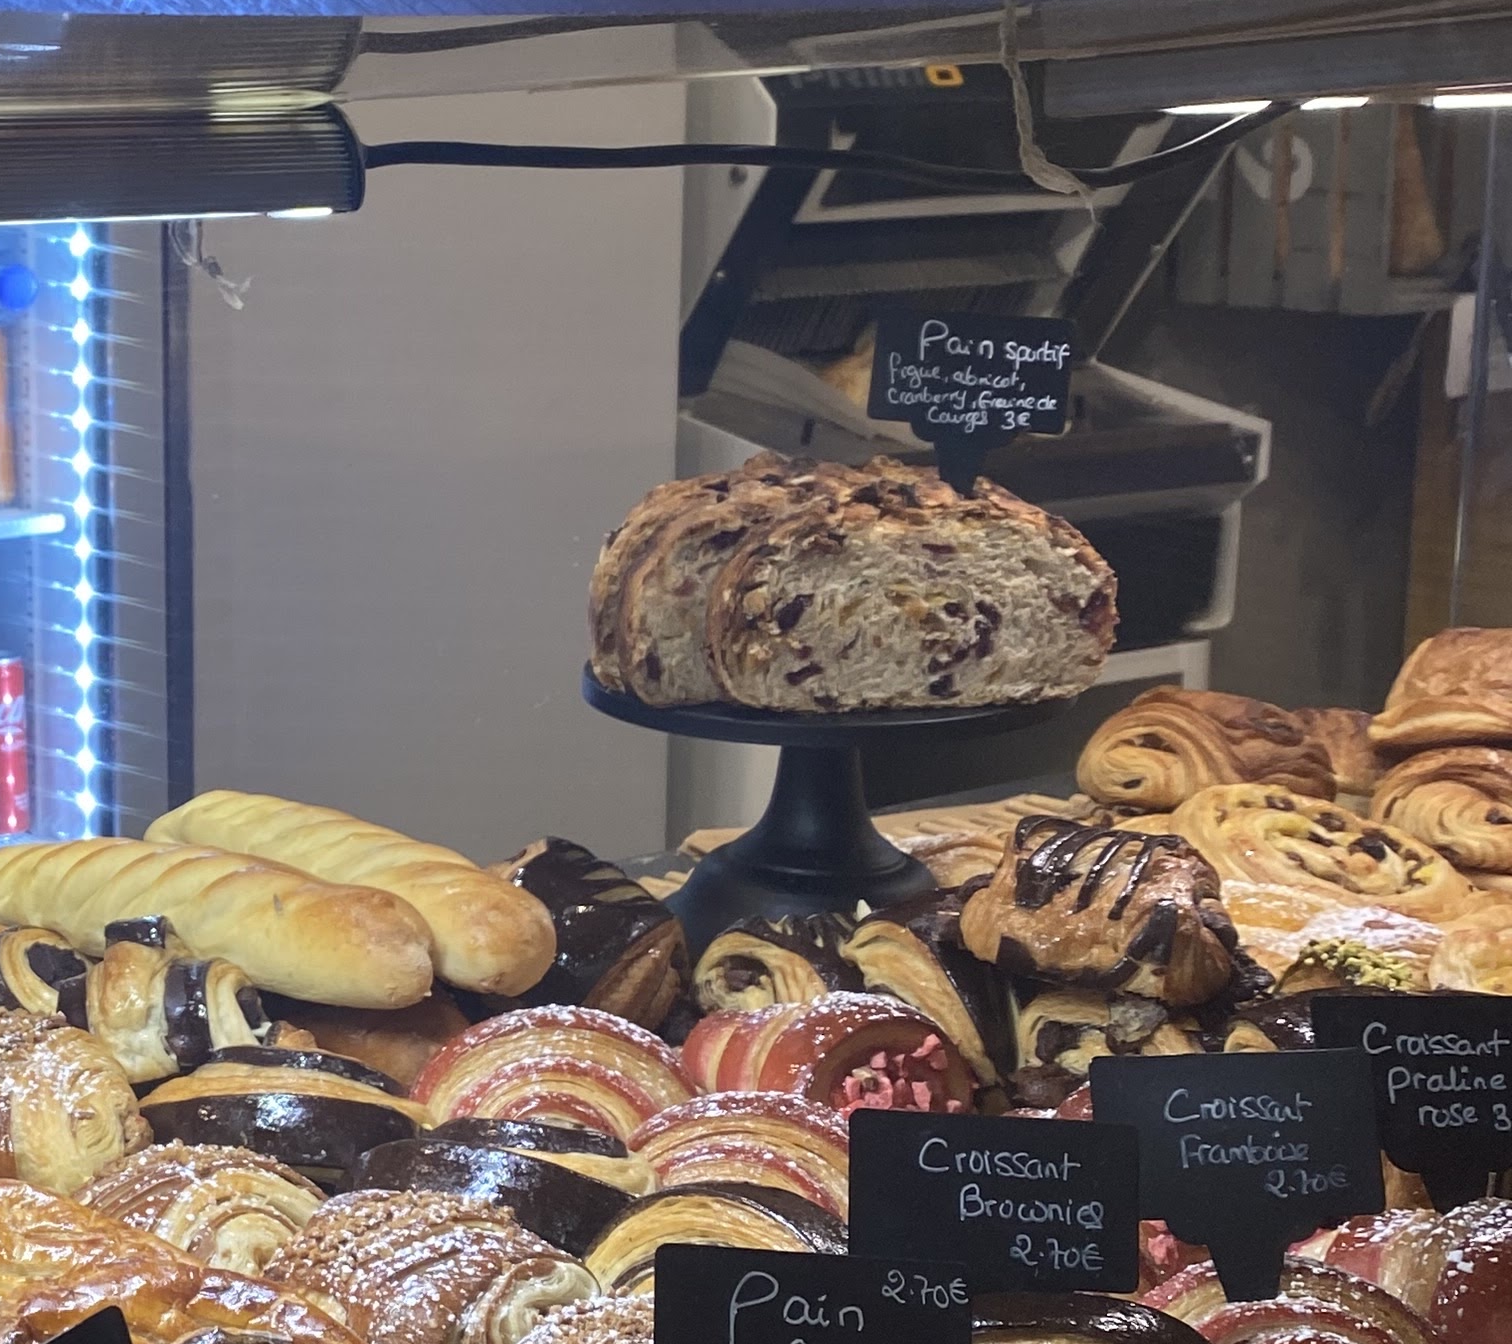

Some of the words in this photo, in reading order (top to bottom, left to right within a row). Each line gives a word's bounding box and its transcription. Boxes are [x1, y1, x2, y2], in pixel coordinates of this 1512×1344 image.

[919, 319, 994, 361] Pain
[1361, 1021, 1512, 1056] Croissant
[1417, 1103, 1479, 1129] rose
[918, 1137, 1082, 1182] Croissant
[1009, 1234, 1105, 1277] 2.70€
[880, 1268, 970, 1309] 2.70€
